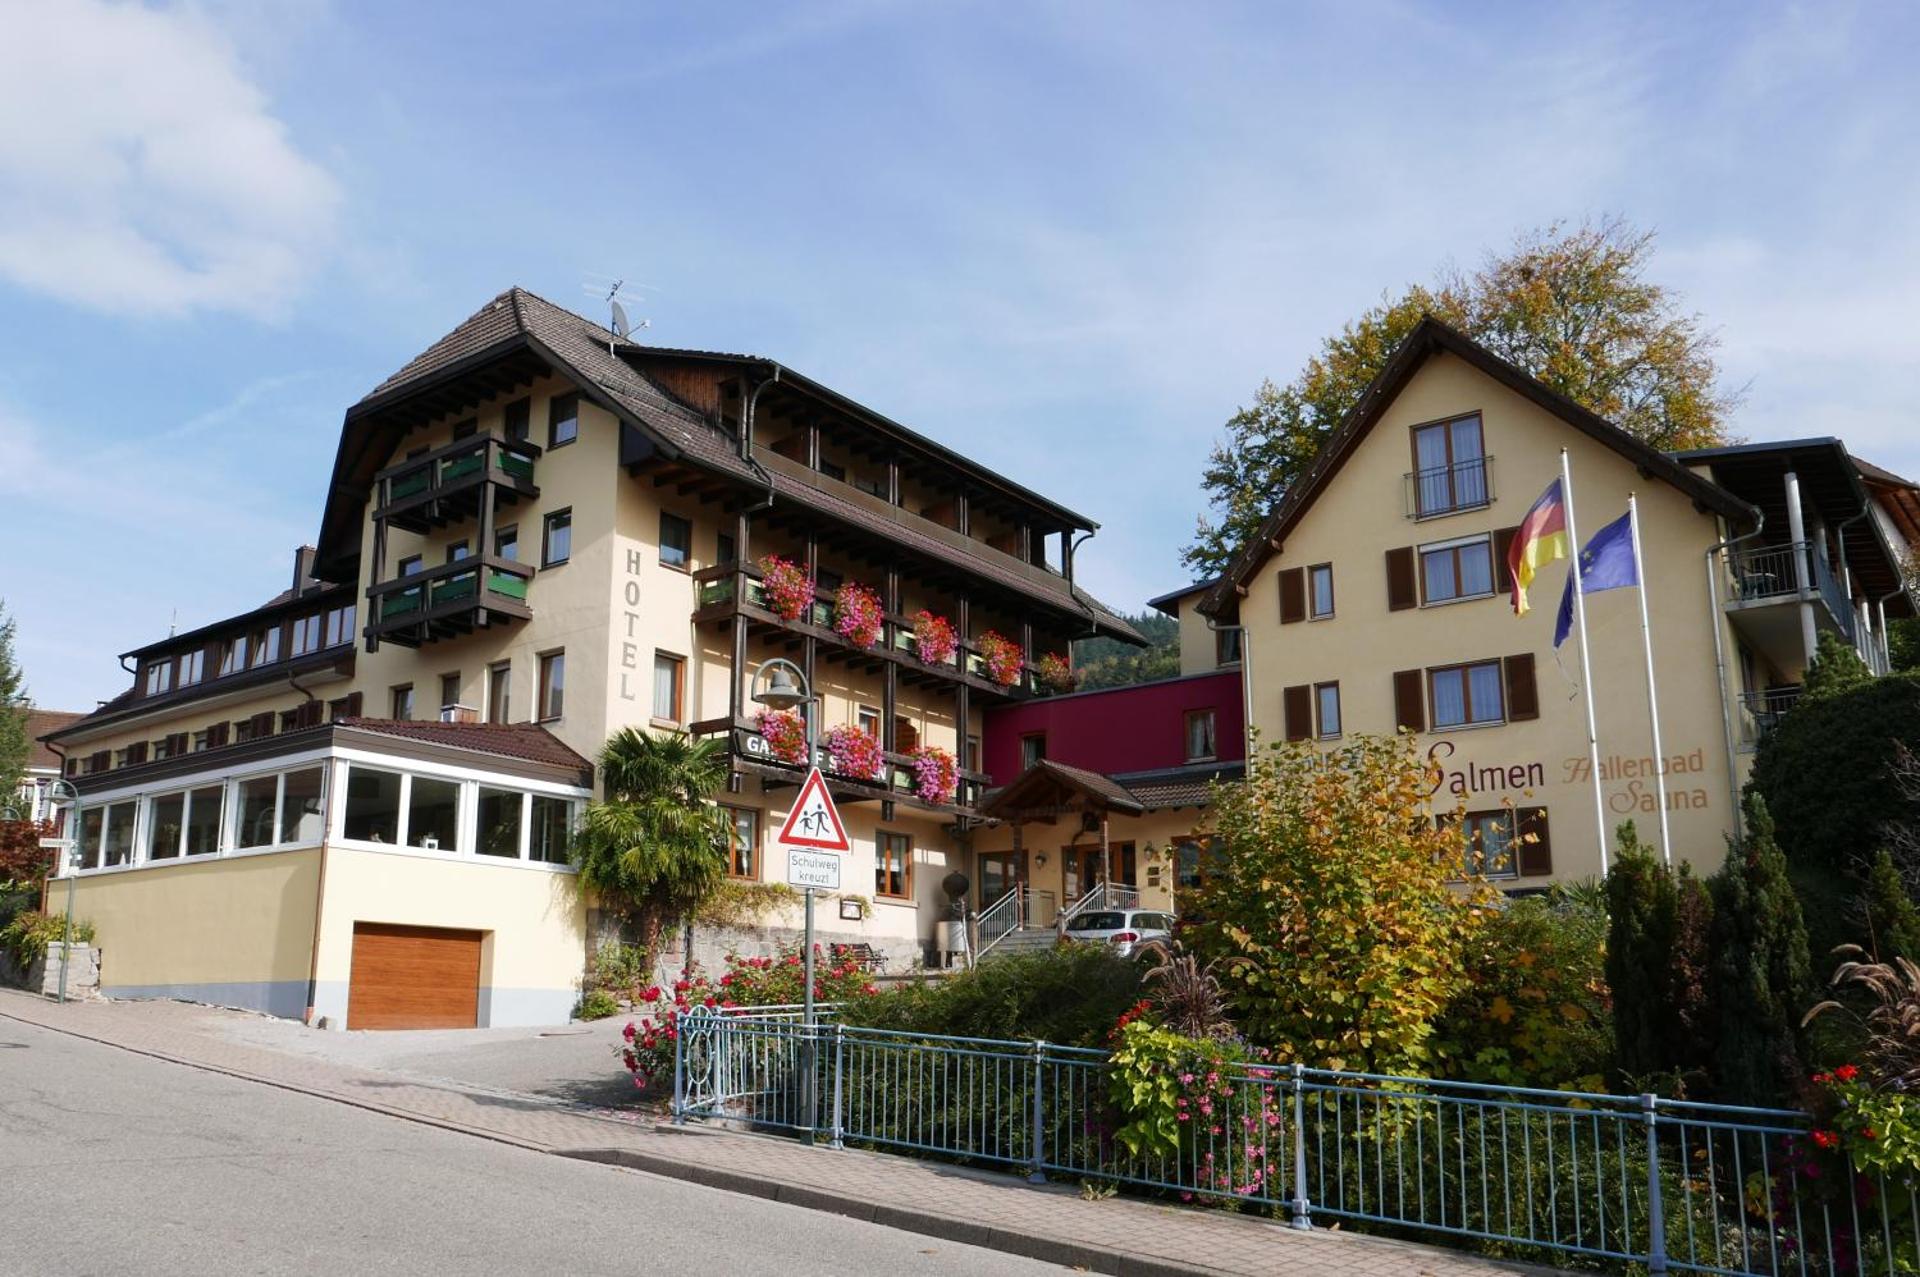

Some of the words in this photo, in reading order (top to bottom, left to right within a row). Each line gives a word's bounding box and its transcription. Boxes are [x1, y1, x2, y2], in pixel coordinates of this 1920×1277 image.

[619, 548, 641, 702] HOTEL
[791, 854, 838, 872] Schulweg
[800, 870, 829, 884] kreuzt
